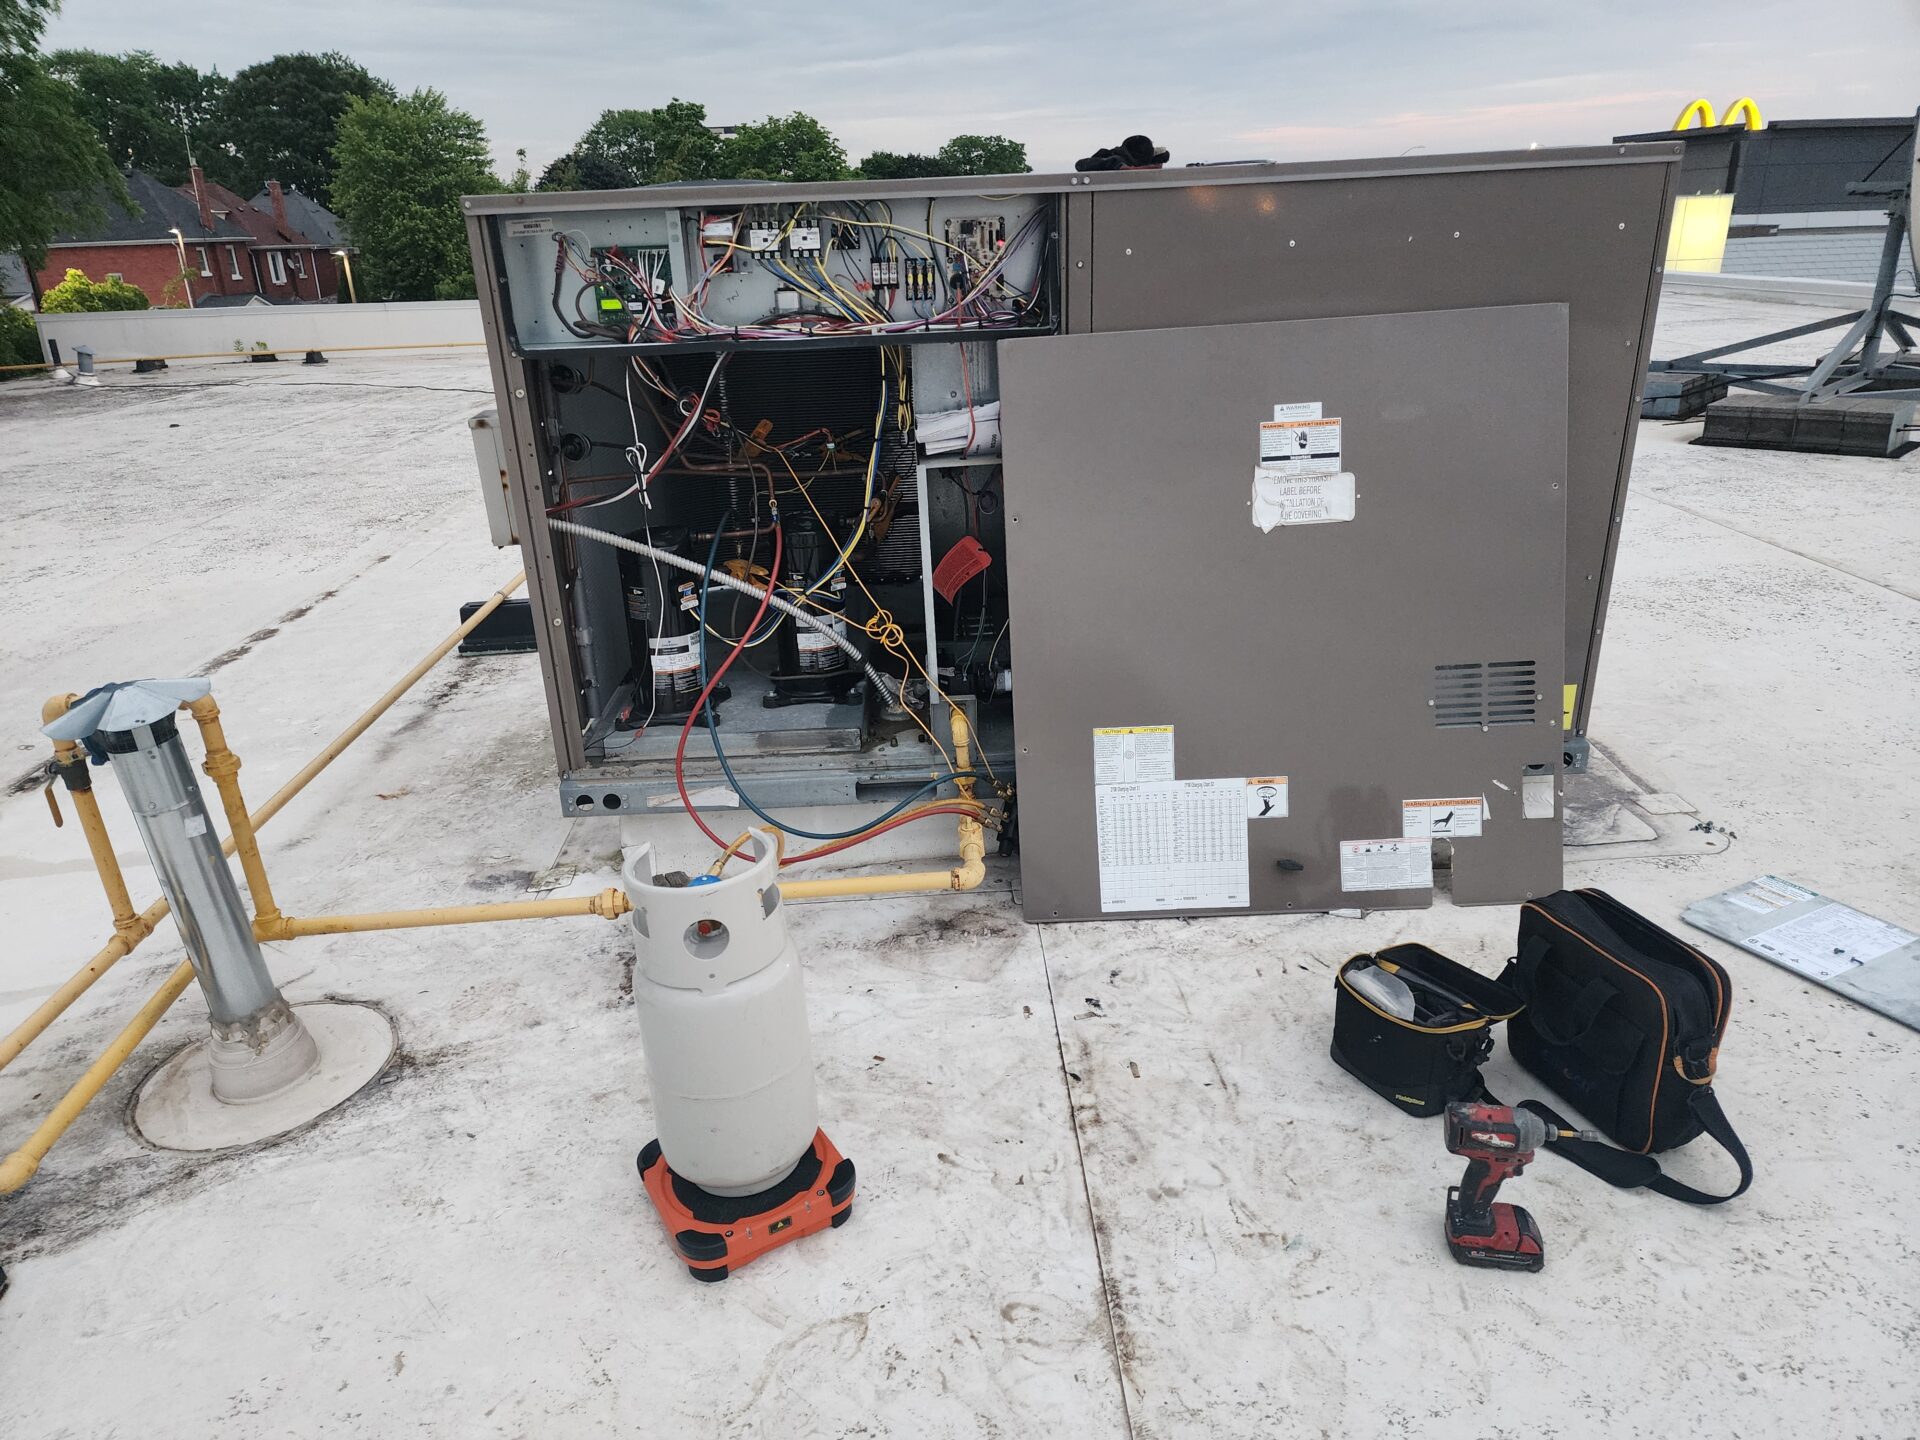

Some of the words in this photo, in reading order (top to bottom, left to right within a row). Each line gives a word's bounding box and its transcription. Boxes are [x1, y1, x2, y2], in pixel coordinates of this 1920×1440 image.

[1279, 486, 1298, 496] LABEL
[1298, 485, 1322, 495] BEFORE
[1317, 497, 1325, 507] OF
[1293, 509, 1322, 520] COVERING
[1439, 798, 1481, 806] AVERTISSEMENT
